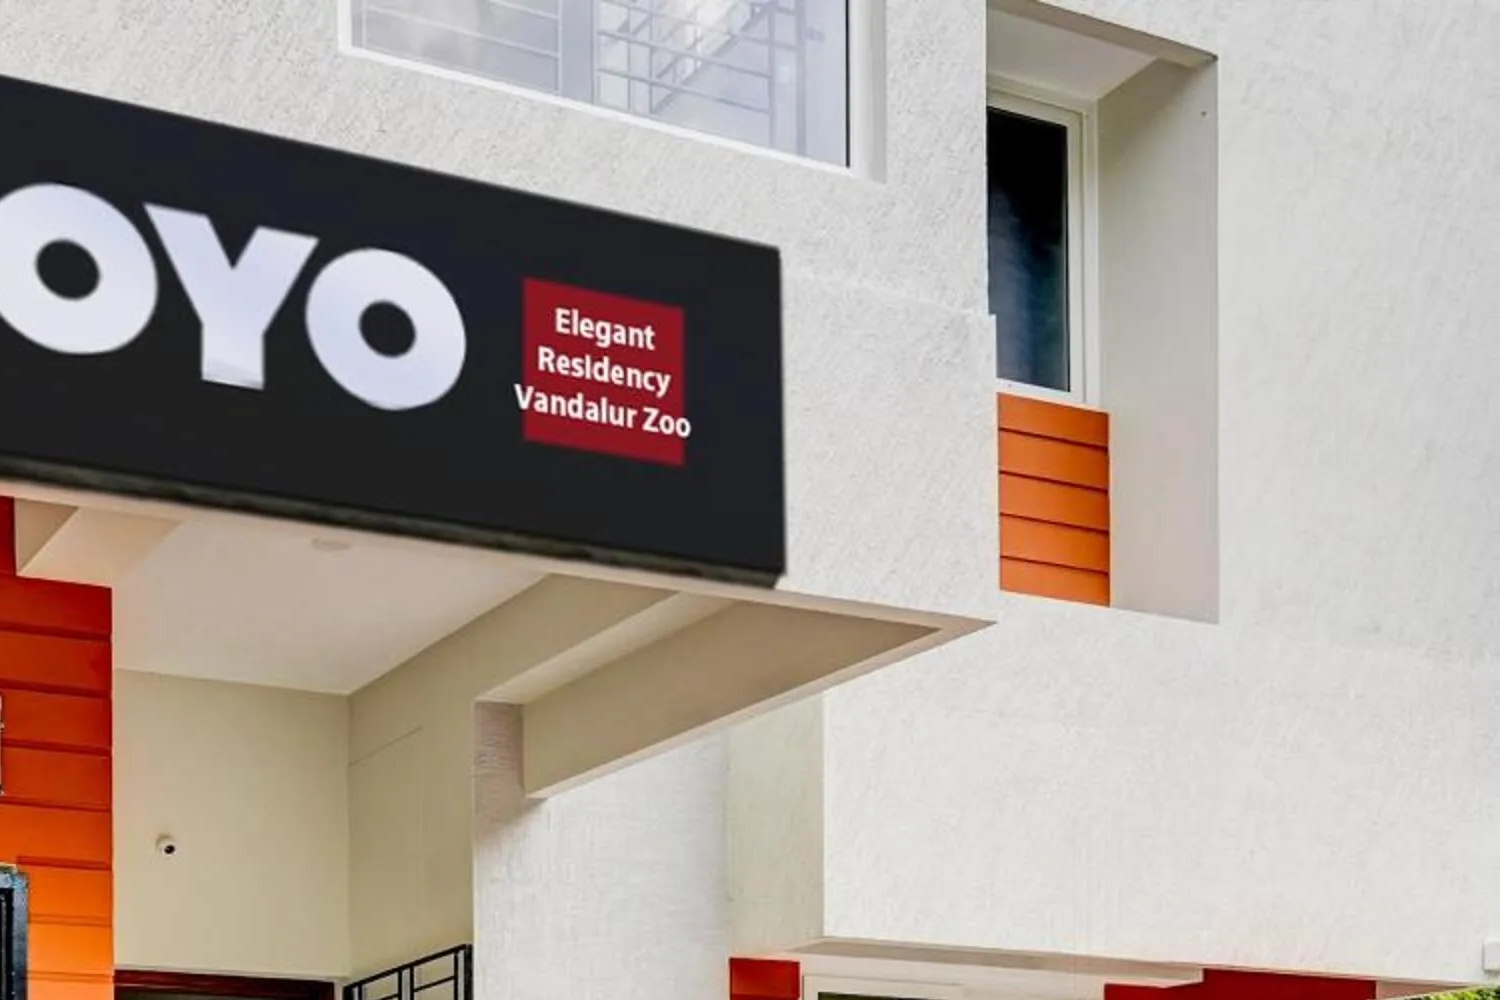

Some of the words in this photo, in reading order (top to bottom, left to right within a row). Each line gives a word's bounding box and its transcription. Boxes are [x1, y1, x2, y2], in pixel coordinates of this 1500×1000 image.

[555, 307, 656, 351] Elegant
[538, 345, 671, 399] Residency
[514, 383, 638, 430] Vandalur
[642, 406, 692, 438] Zoo
